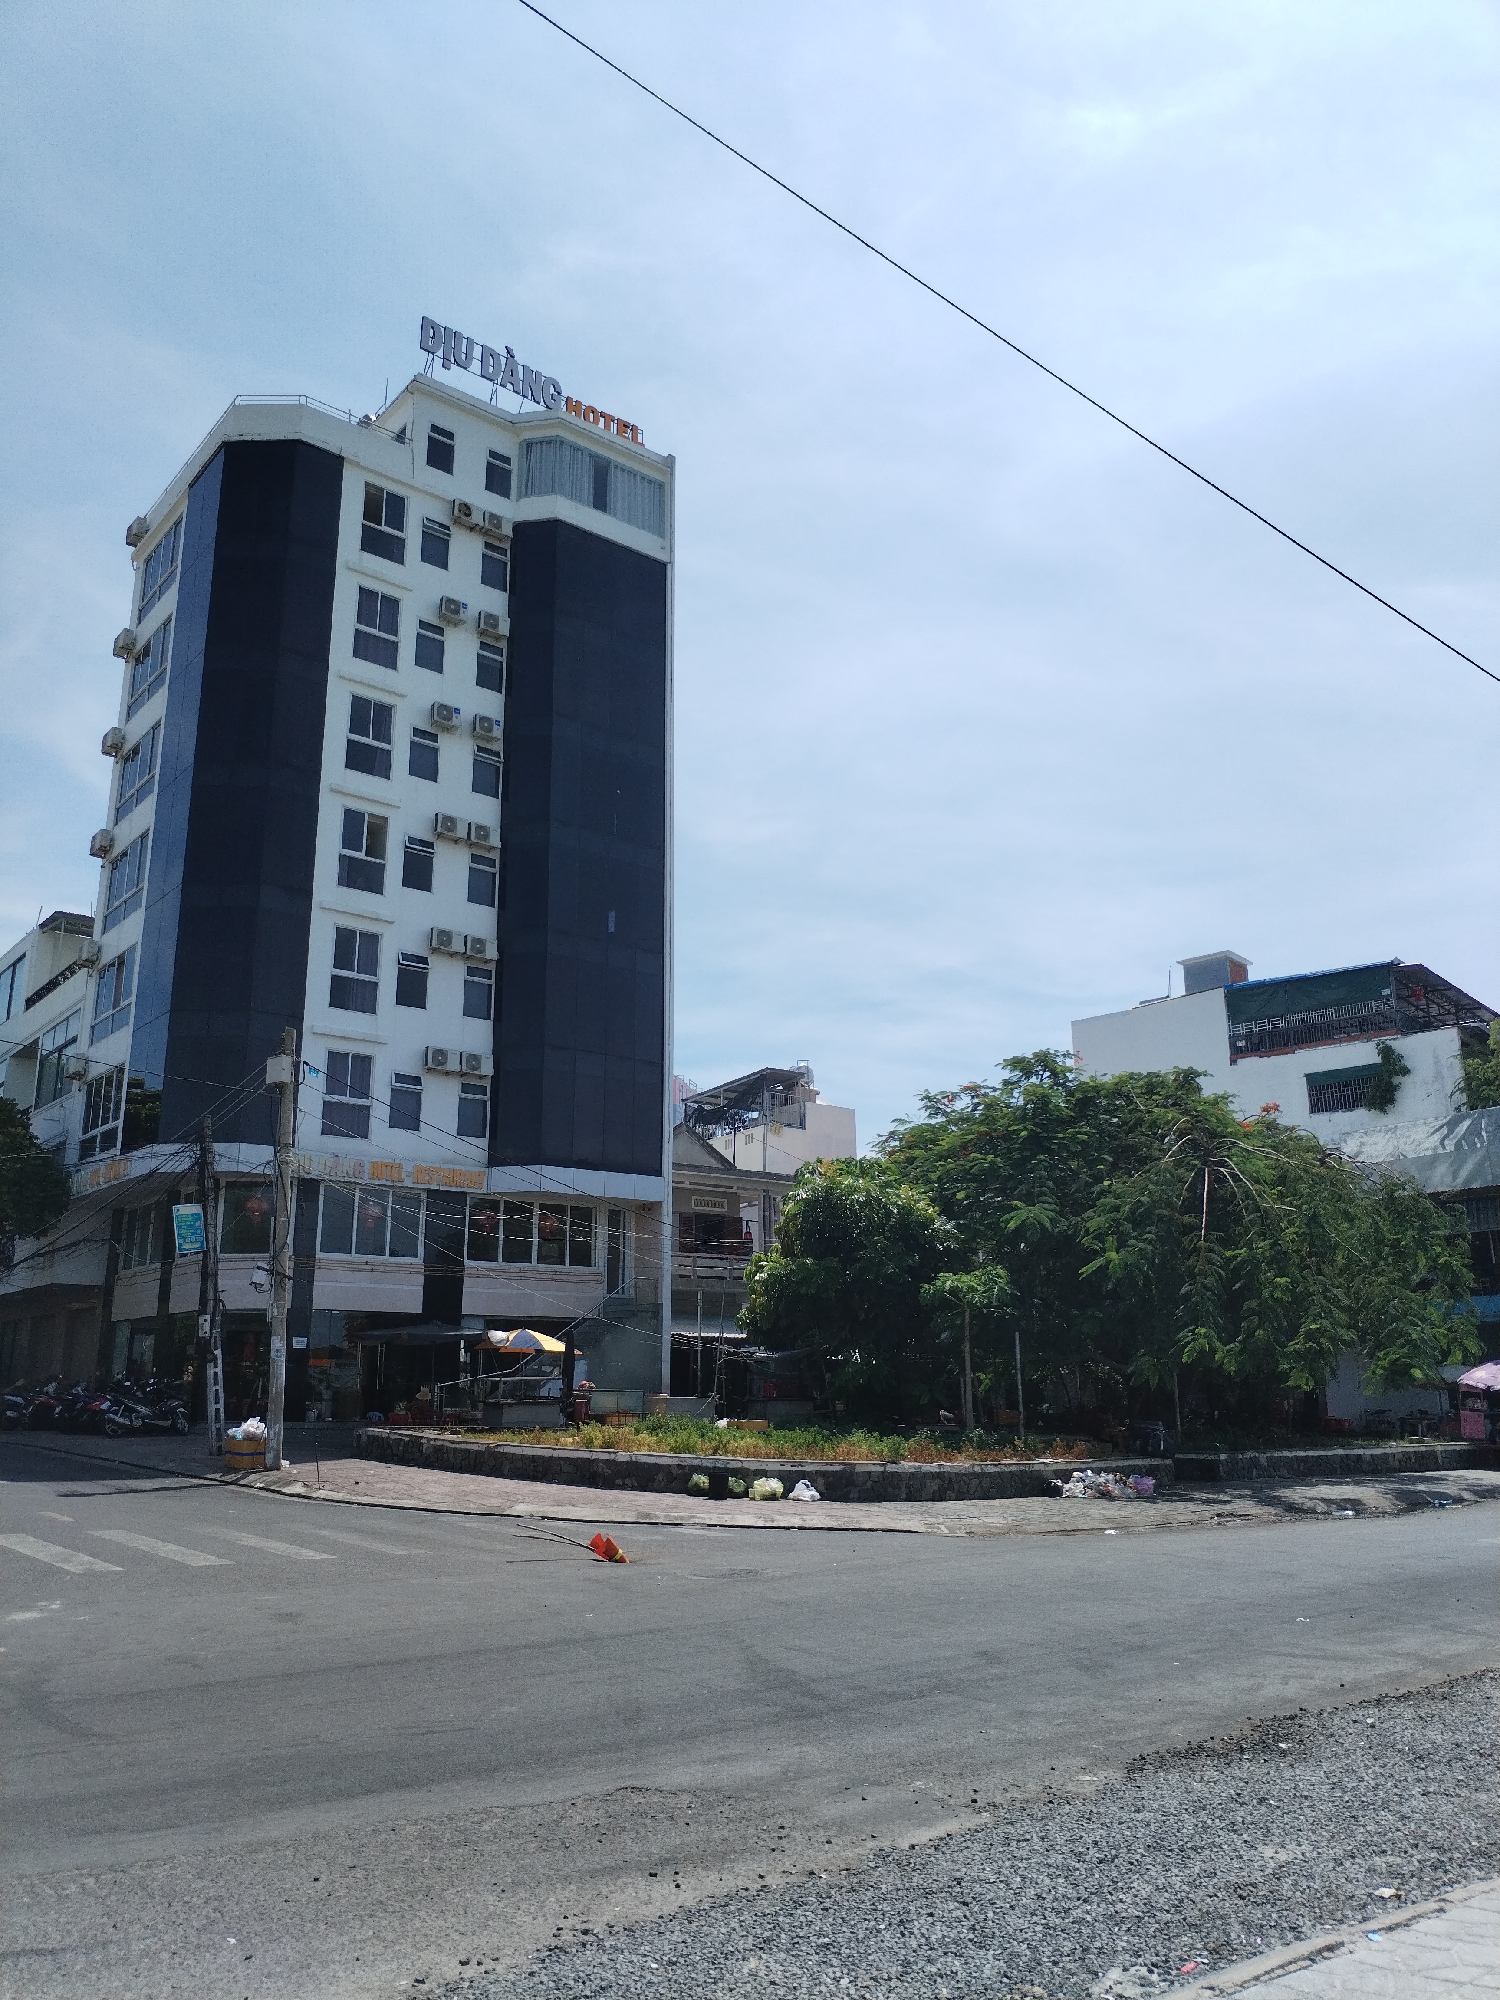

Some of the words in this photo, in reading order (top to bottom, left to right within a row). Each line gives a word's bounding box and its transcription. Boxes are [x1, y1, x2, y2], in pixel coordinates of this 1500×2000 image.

[420, 315, 475, 371] DỊU
[481, 345, 563, 411] DÀNG
[566, 396, 645, 447] HOTEL
[369, 1160, 405, 1182] HOTEL
[413, 1164, 486, 1190] RESTAURANT
